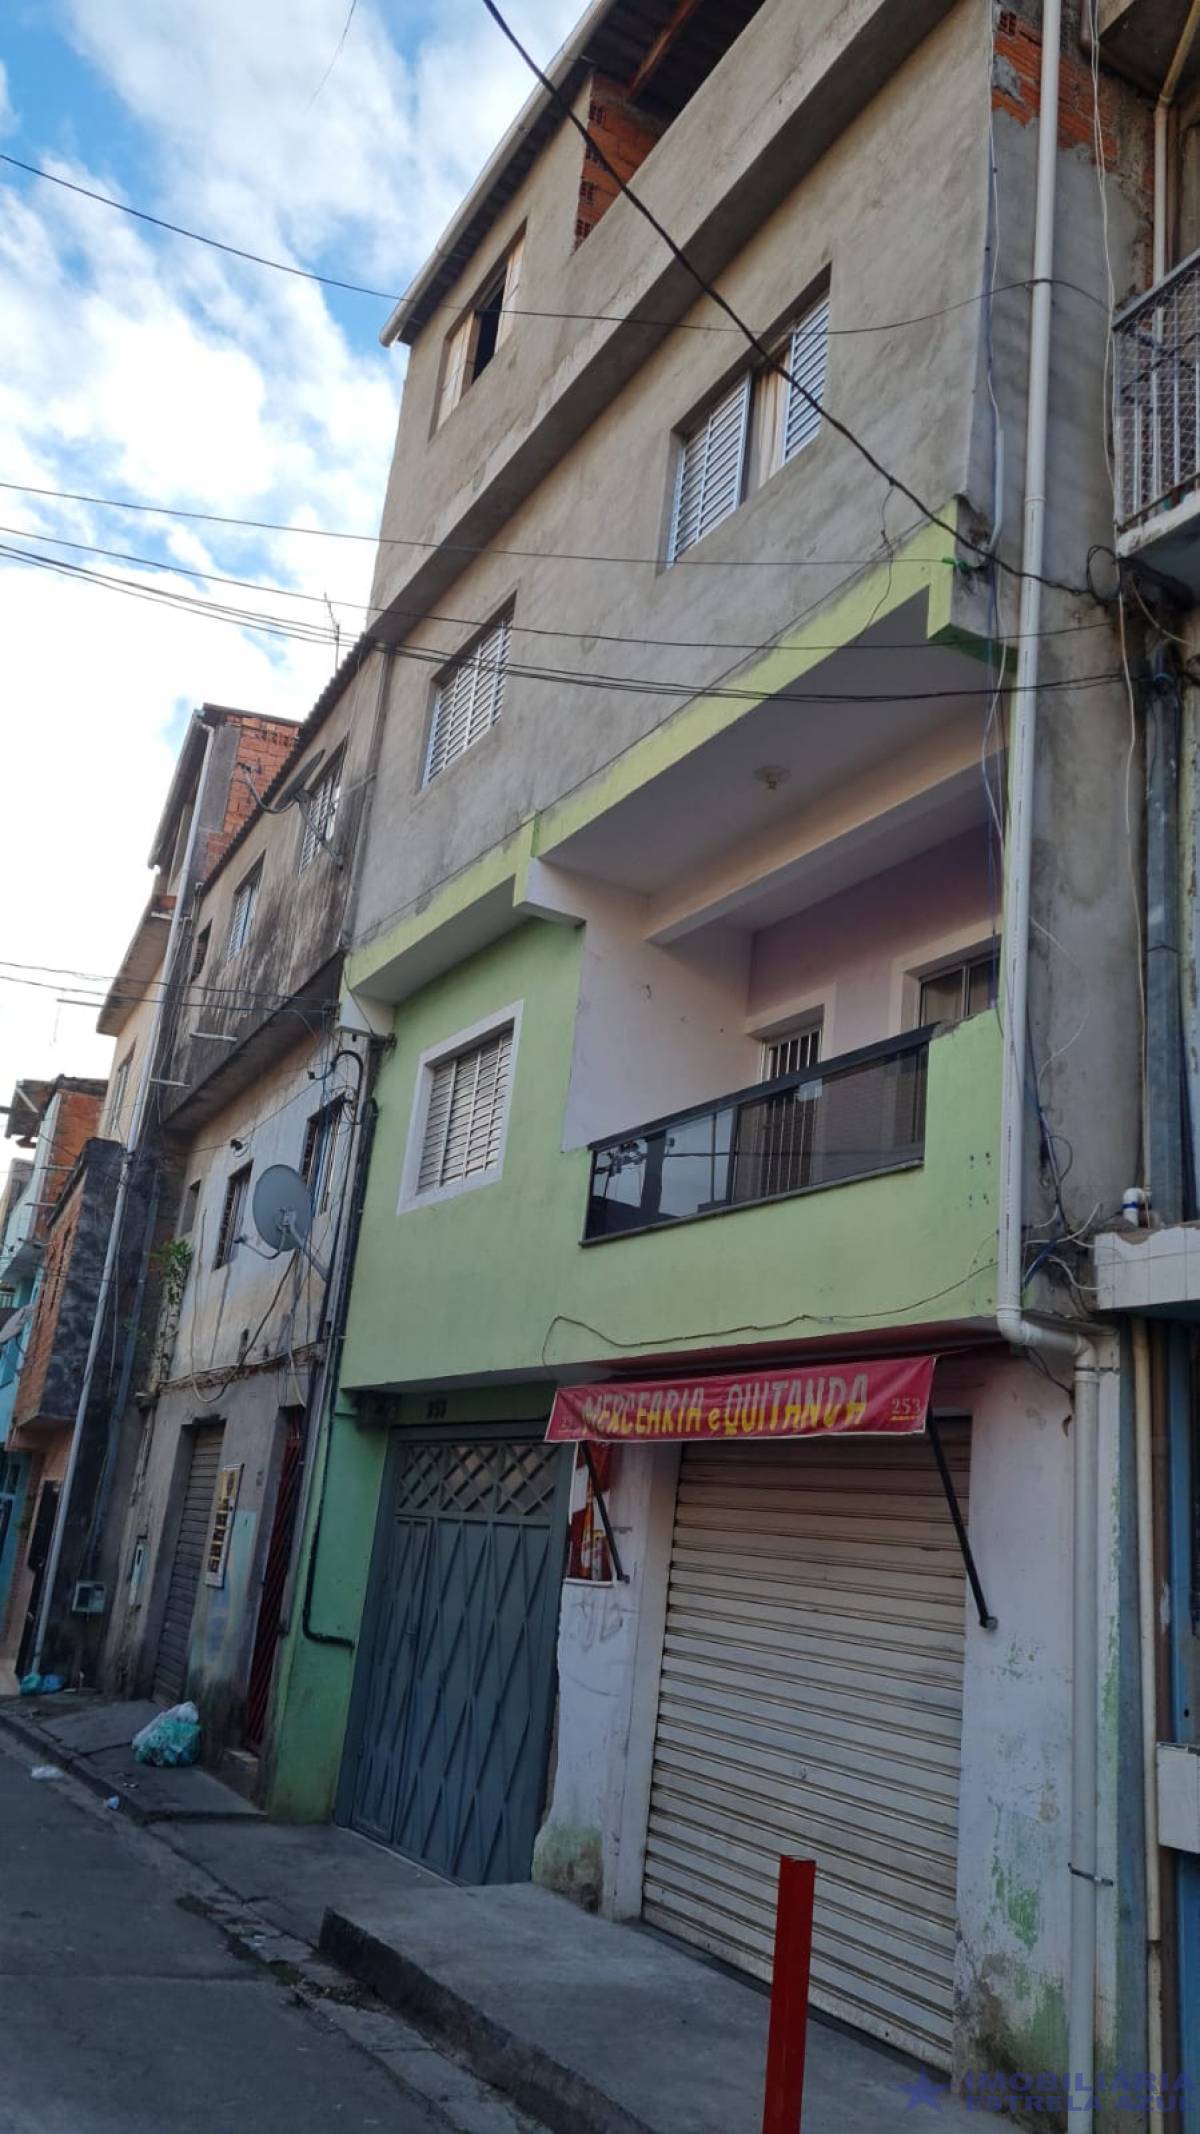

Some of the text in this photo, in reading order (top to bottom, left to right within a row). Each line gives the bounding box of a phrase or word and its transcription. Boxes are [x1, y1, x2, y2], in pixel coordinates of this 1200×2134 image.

[581, 1374, 869, 1435] MERCEARIA e QUITANDA
[891, 1397, 922, 1416] 253
